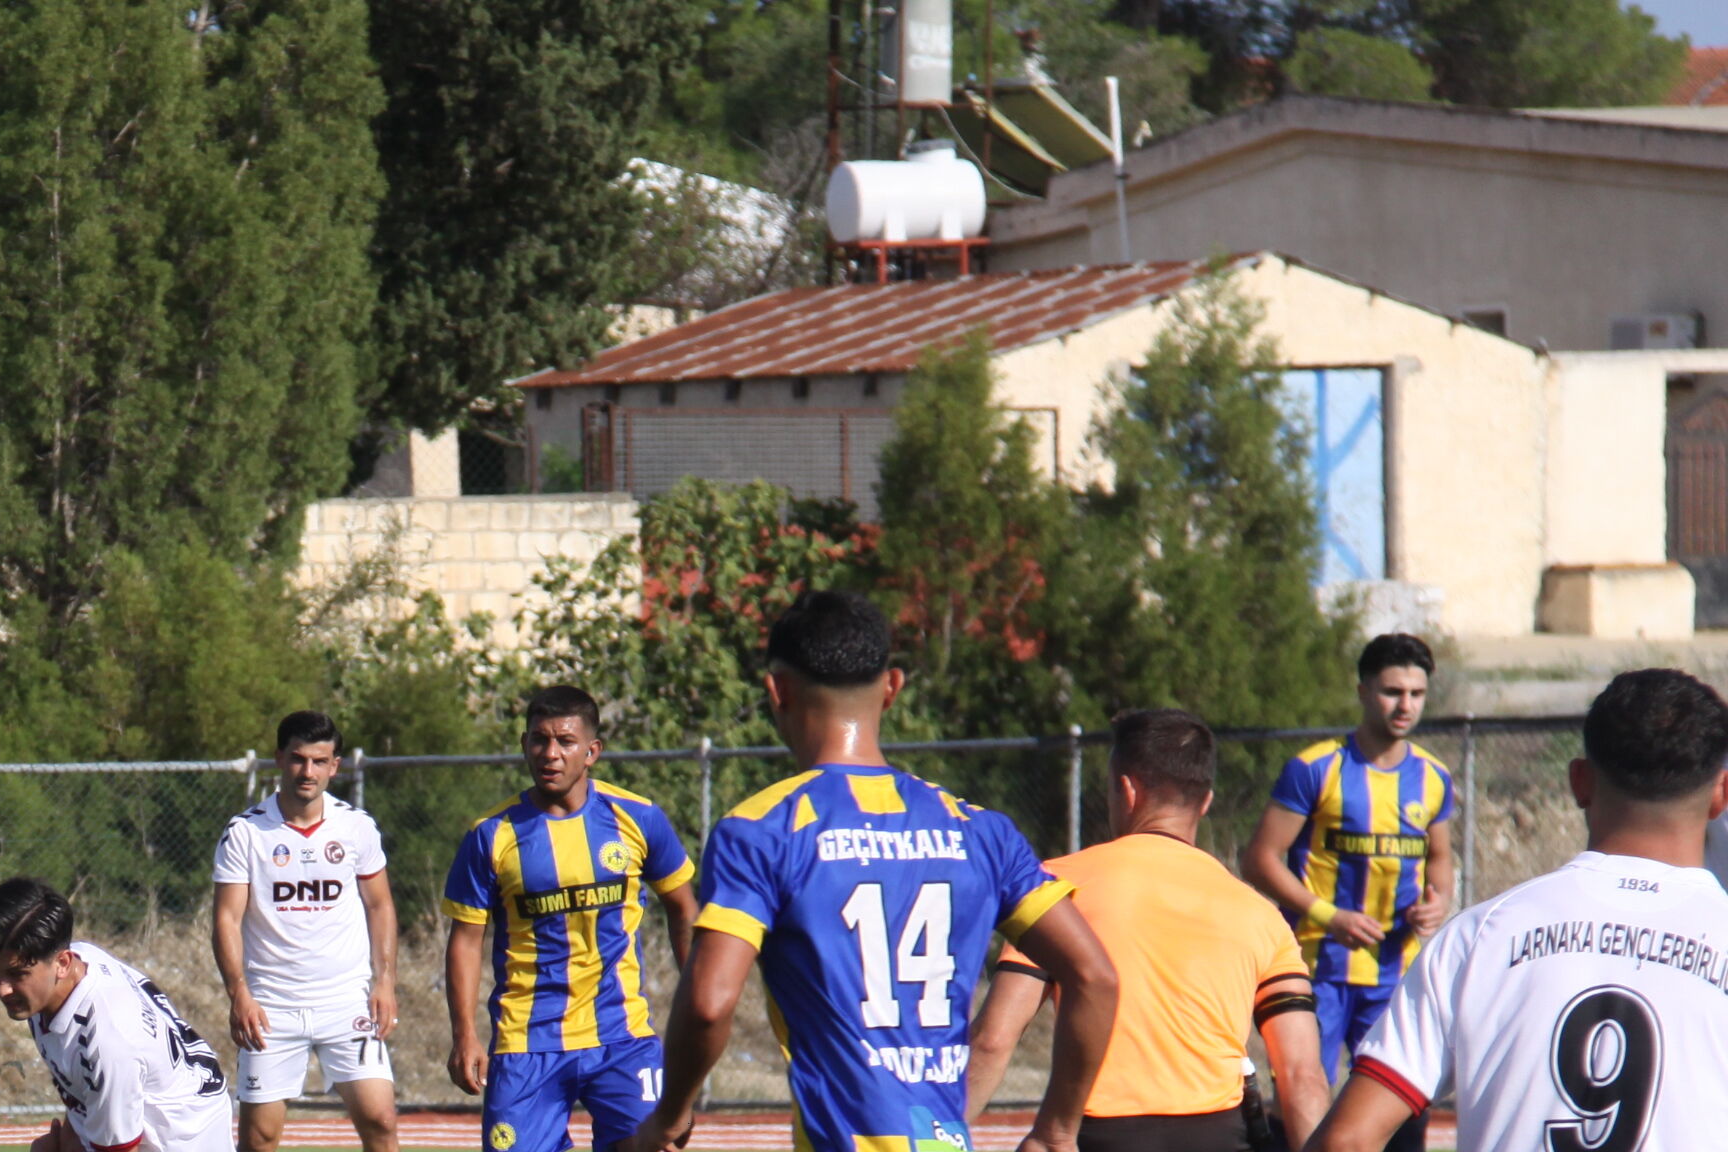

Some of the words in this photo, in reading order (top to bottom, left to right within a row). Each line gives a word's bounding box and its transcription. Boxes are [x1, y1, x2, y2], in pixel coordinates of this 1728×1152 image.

[816, 822, 967, 866] GEÇİTKALE
[1380, 836, 1425, 857] FARM
[273, 879, 343, 903] DND
[575, 884, 623, 907] FARM
[1617, 878, 1660, 894] 1934
[841, 881, 956, 1028] 14
[1508, 920, 1593, 969] LARNAKA
